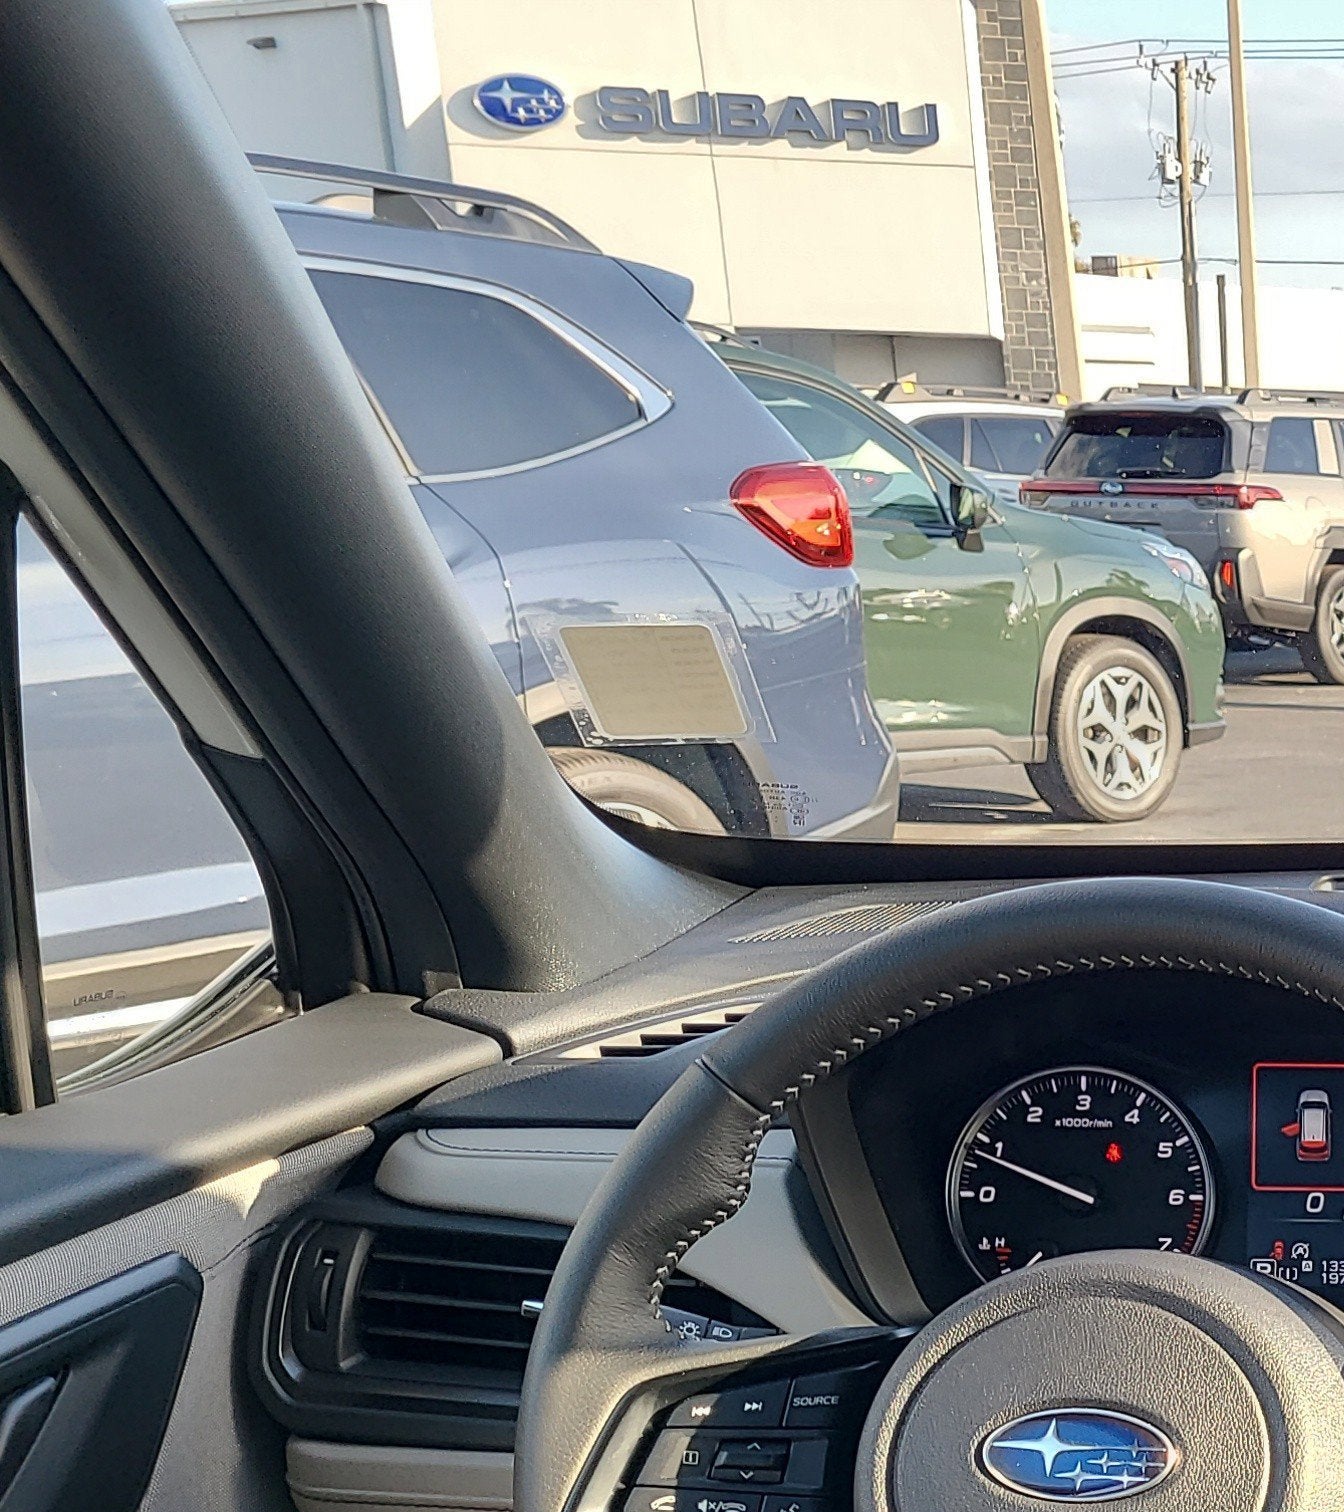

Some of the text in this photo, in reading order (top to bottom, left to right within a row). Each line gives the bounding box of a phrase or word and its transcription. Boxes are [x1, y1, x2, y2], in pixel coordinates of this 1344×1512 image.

[596, 85, 939, 147] SUBARU
[1075, 1095, 1091, 1110] 3
[1026, 1107, 1043, 1123] 2
[1124, 1109, 1140, 1124] 4
[994, 1141, 1003, 1157] 1
[1157, 1142, 1173, 1158] 5
[979, 1186, 995, 1202] 0
[1168, 1190, 1185, 1205] 6
[1306, 1192, 1325, 1213] 0
[1158, 1238, 1173, 1251] 7
[792, 1395, 840, 1407] SOURCE
